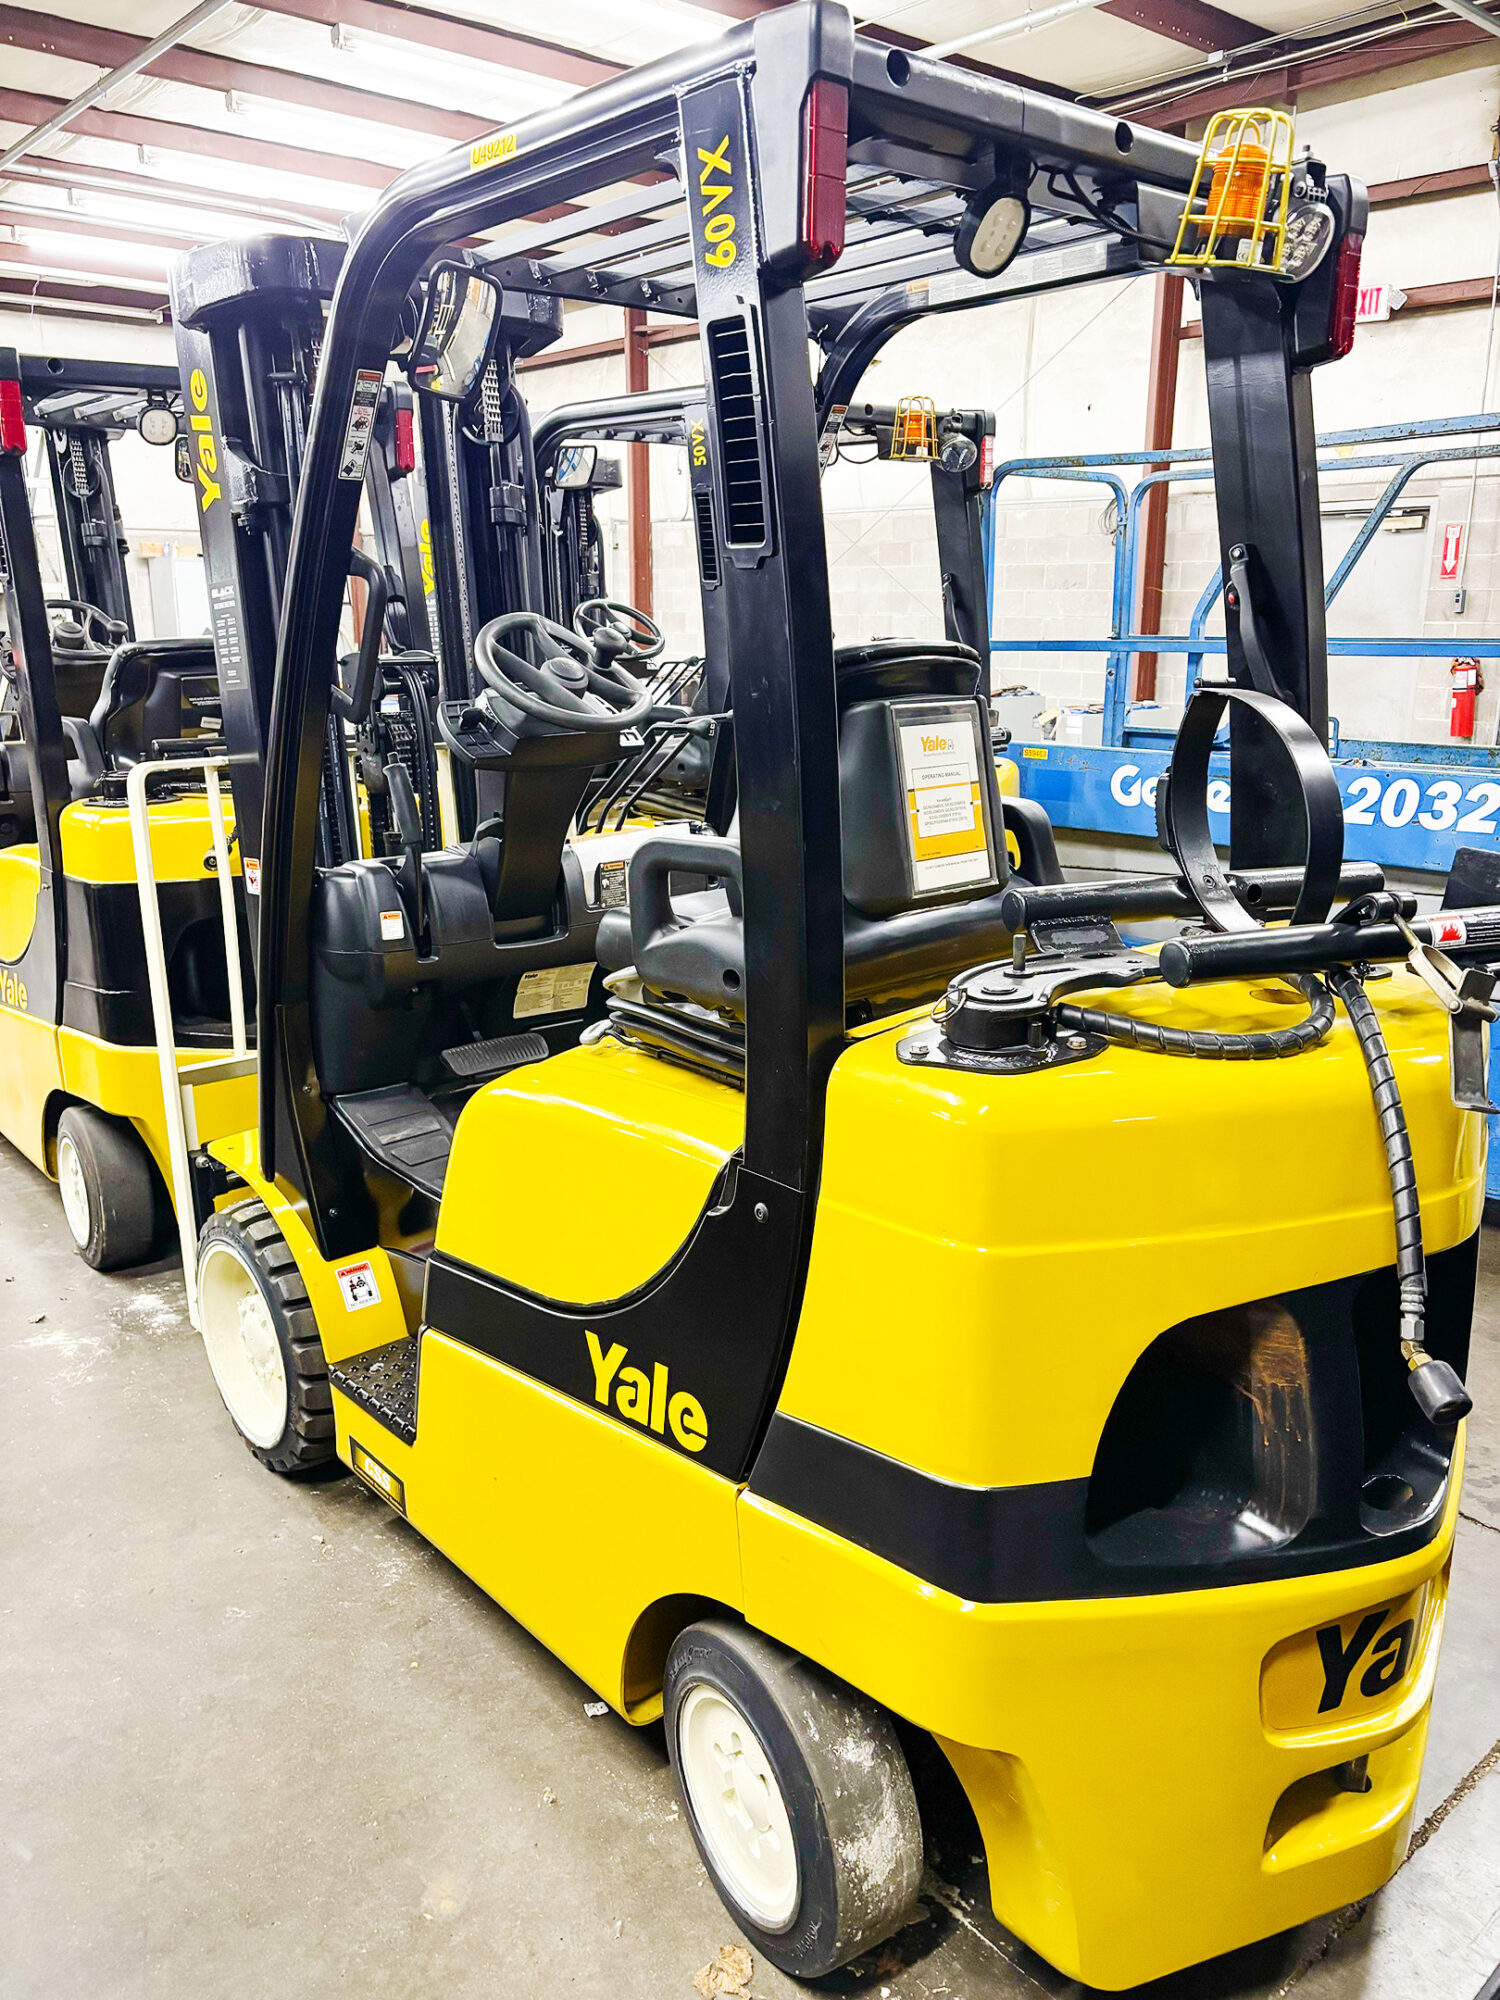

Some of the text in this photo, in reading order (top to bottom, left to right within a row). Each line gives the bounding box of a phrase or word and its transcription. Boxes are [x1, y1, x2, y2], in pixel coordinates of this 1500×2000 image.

[472, 134, 514, 165] U49212
[697, 134, 737, 269] 60VX
[1358, 287, 1383, 316] XIT
[189, 368, 222, 514] Yale
[690, 417, 707, 467] 50VX
[920, 735, 947, 752] Yale
[0, 969, 28, 1010] Yale
[585, 1329, 708, 1453] Yale
[364, 1457, 391, 1492] CSS
[1316, 1608, 1415, 1714] Ya
